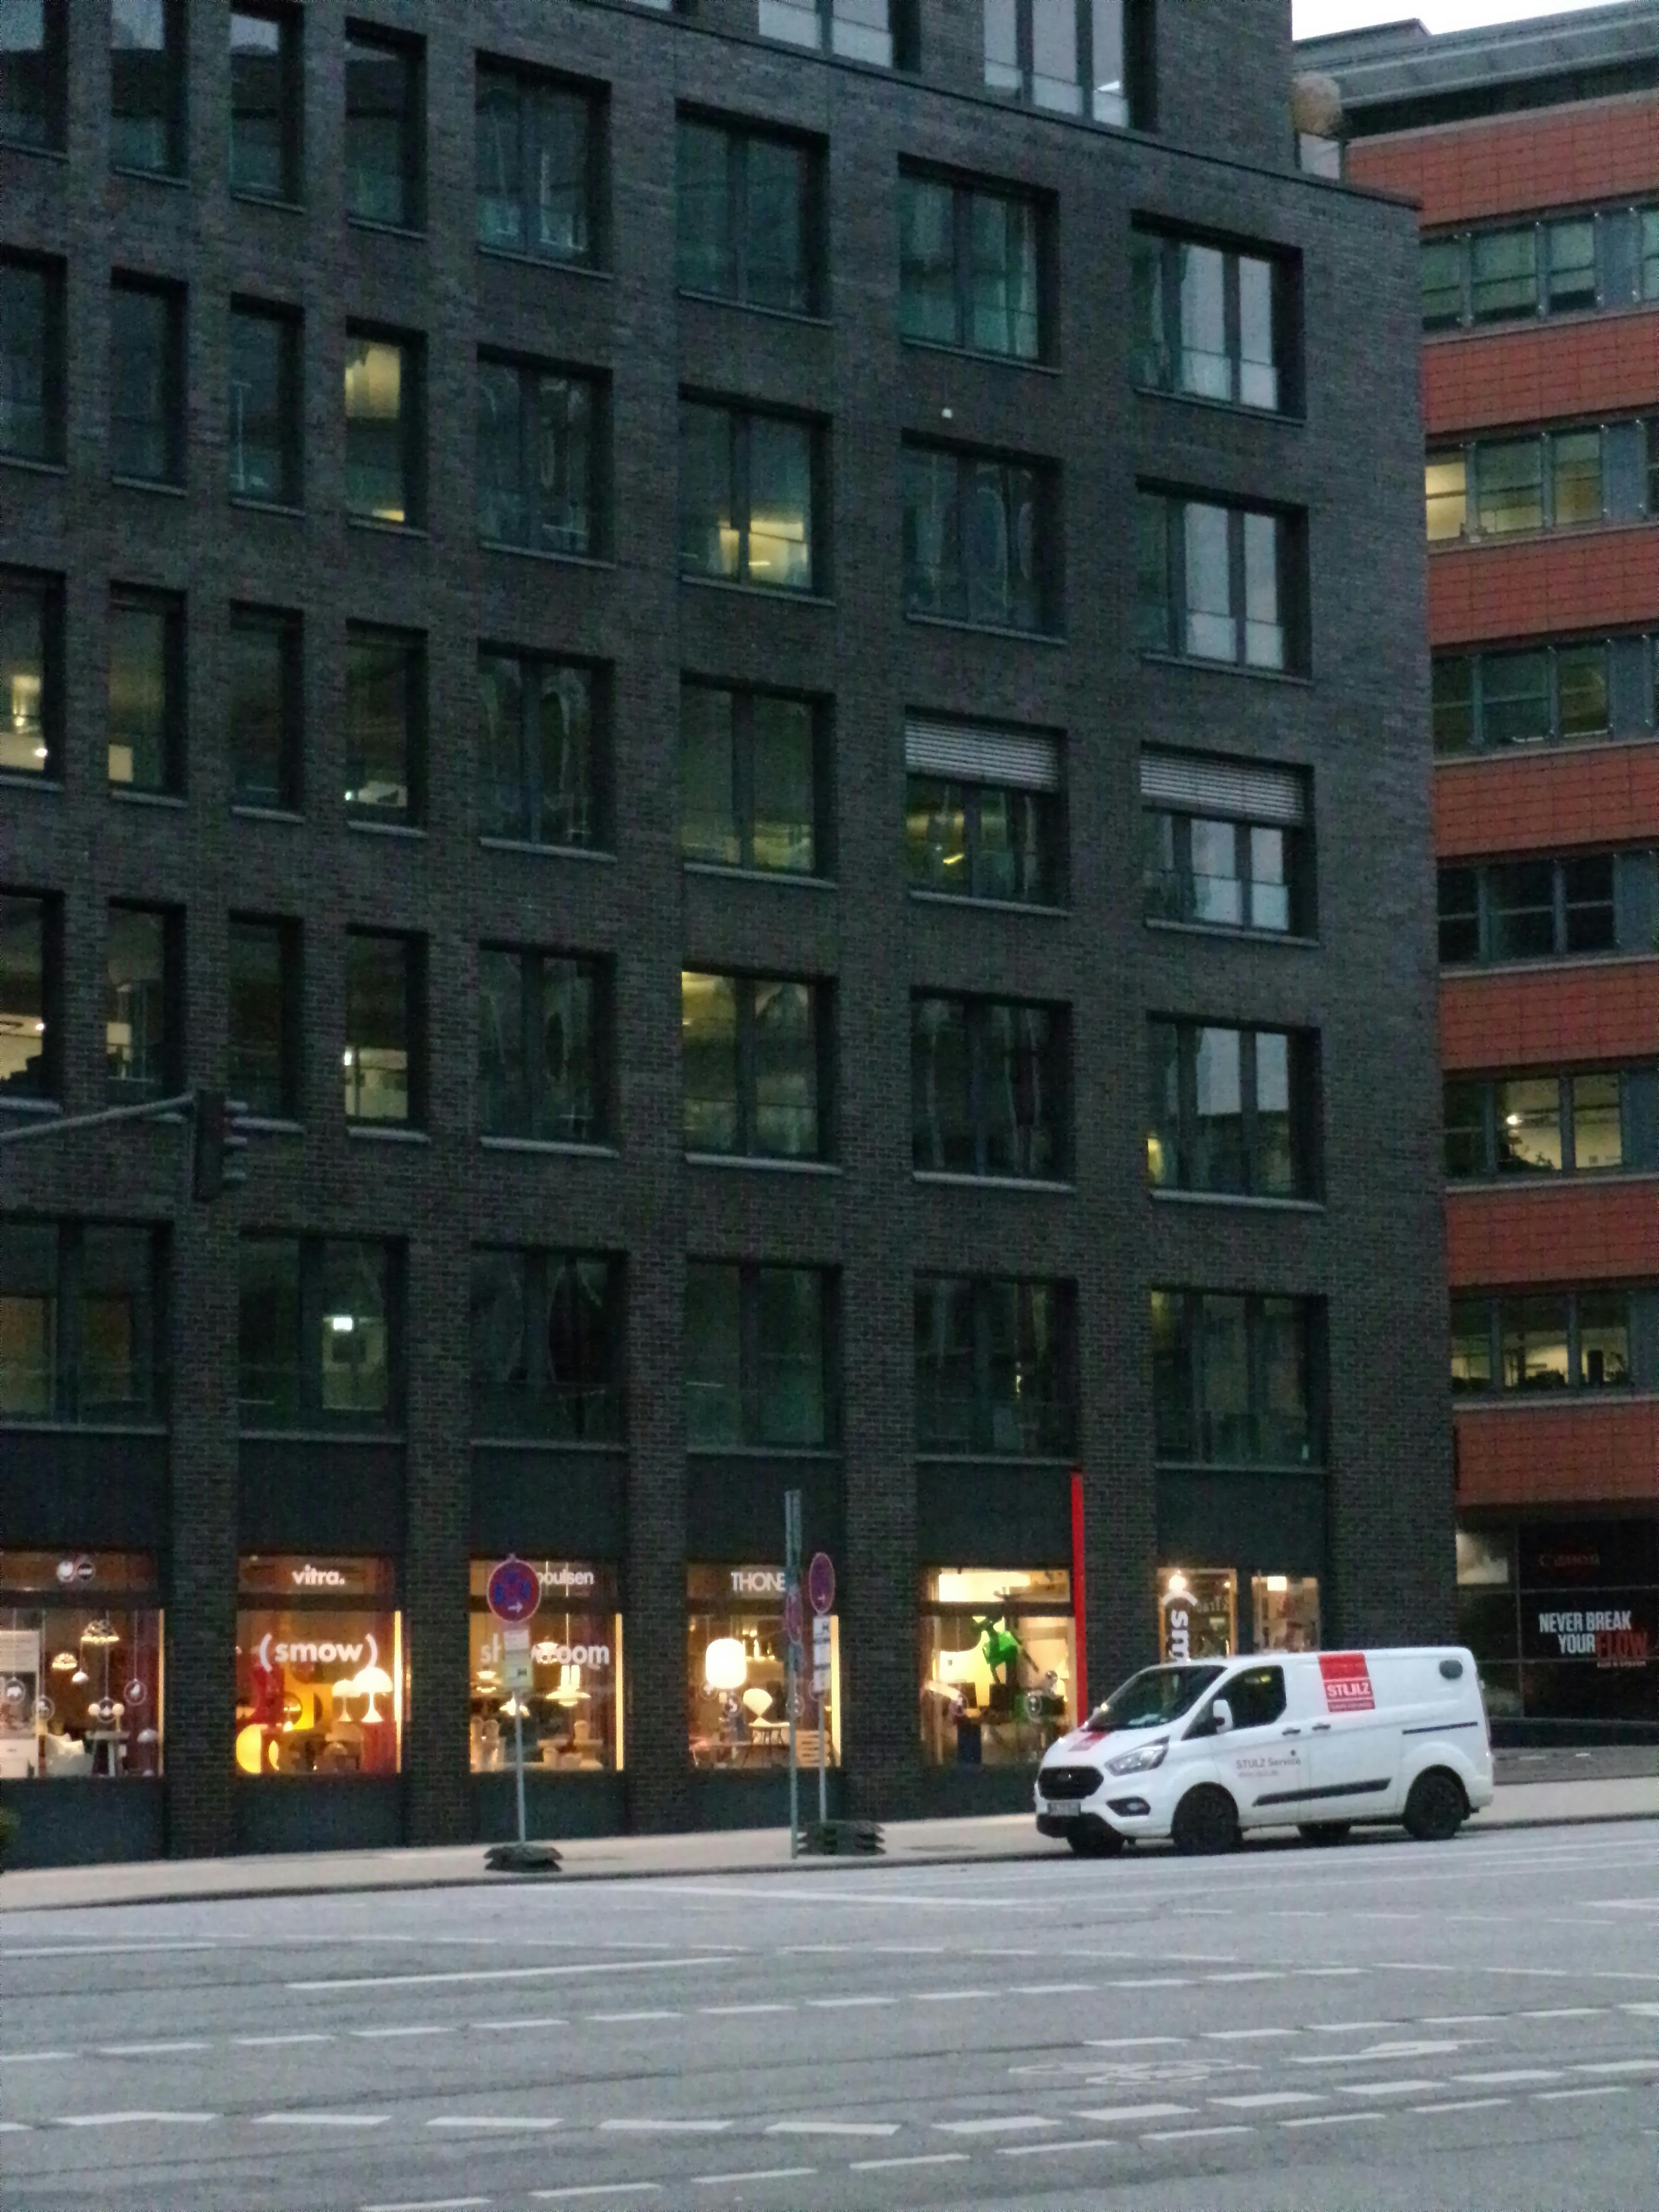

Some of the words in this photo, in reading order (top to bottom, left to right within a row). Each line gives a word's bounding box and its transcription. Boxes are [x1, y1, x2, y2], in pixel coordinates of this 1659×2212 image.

[292, 1563, 346, 1586] vitra.
[731, 1571, 786, 1592] THONE
[1539, 1612, 1583, 1633] NEVER
[1586, 1611, 1632, 1631] BREAK
[1558, 1633, 1595, 1654] YOUR
[1327, 1682, 1370, 1696] STULZ
[1236, 1758, 1265, 1769] STULZ
